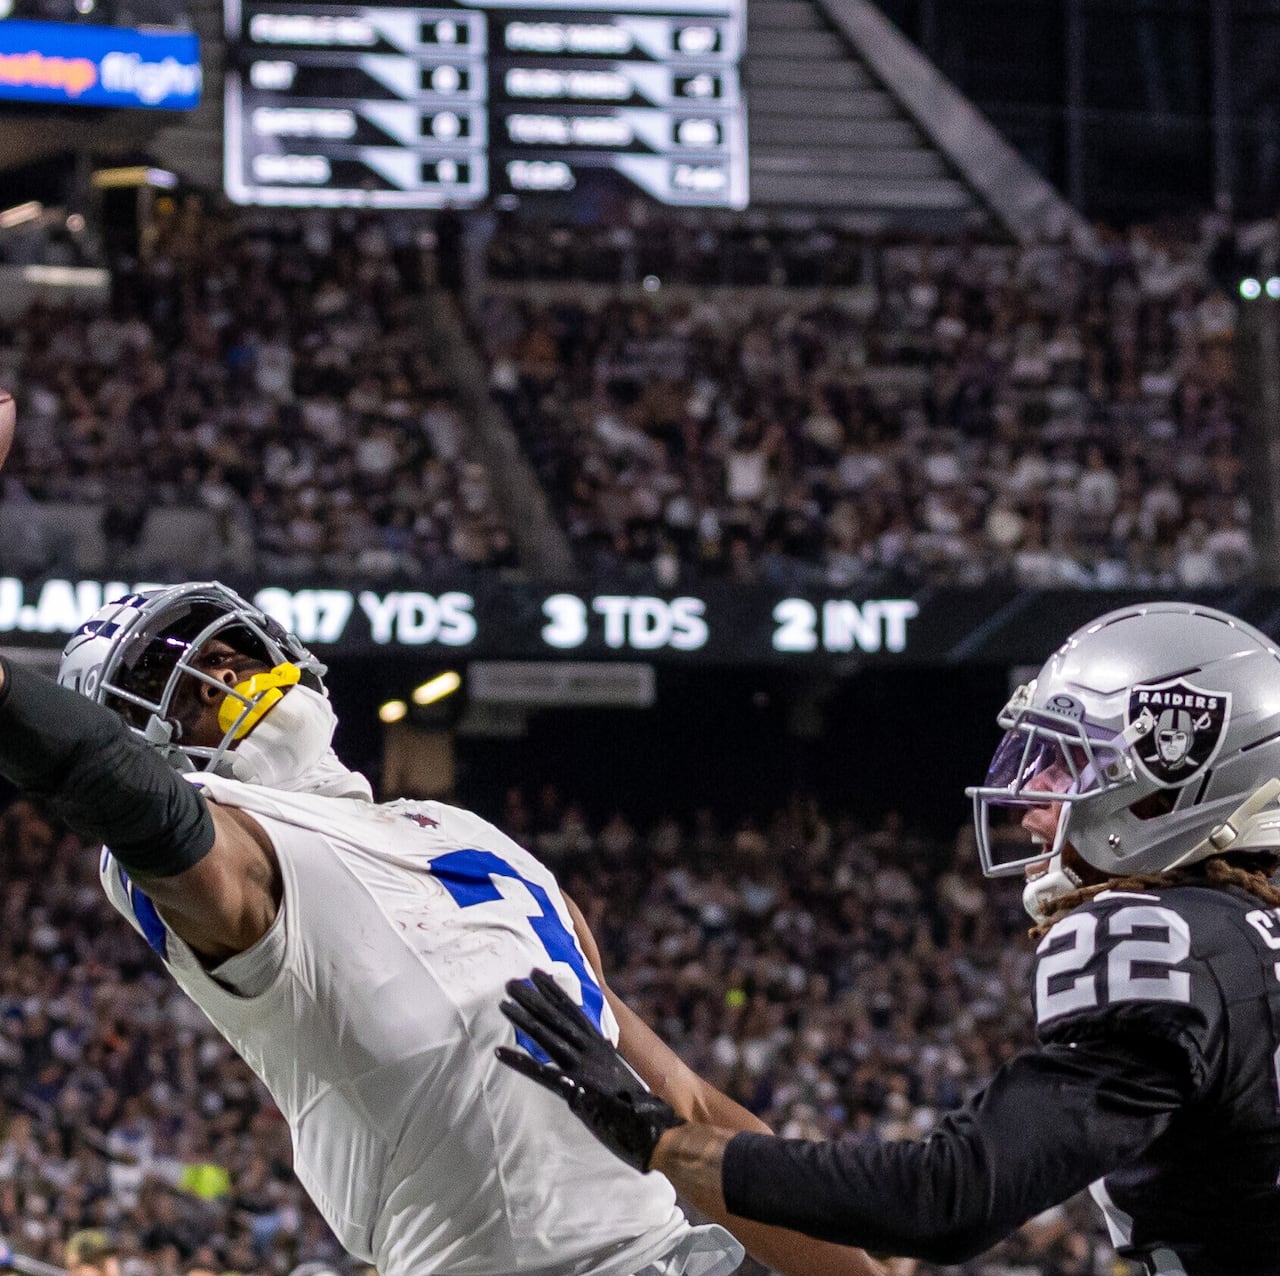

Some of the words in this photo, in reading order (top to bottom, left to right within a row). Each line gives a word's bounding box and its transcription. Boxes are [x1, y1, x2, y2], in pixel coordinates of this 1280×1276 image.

[361, 592, 478, 647] YDS
[541, 594, 589, 650] 3
[593, 595, 710, 652] TDS
[772, 598, 818, 653] 2
[821, 598, 918, 653] INT
[1138, 691, 1218, 710] RAIDERS
[1036, 905, 1191, 1025] 22
